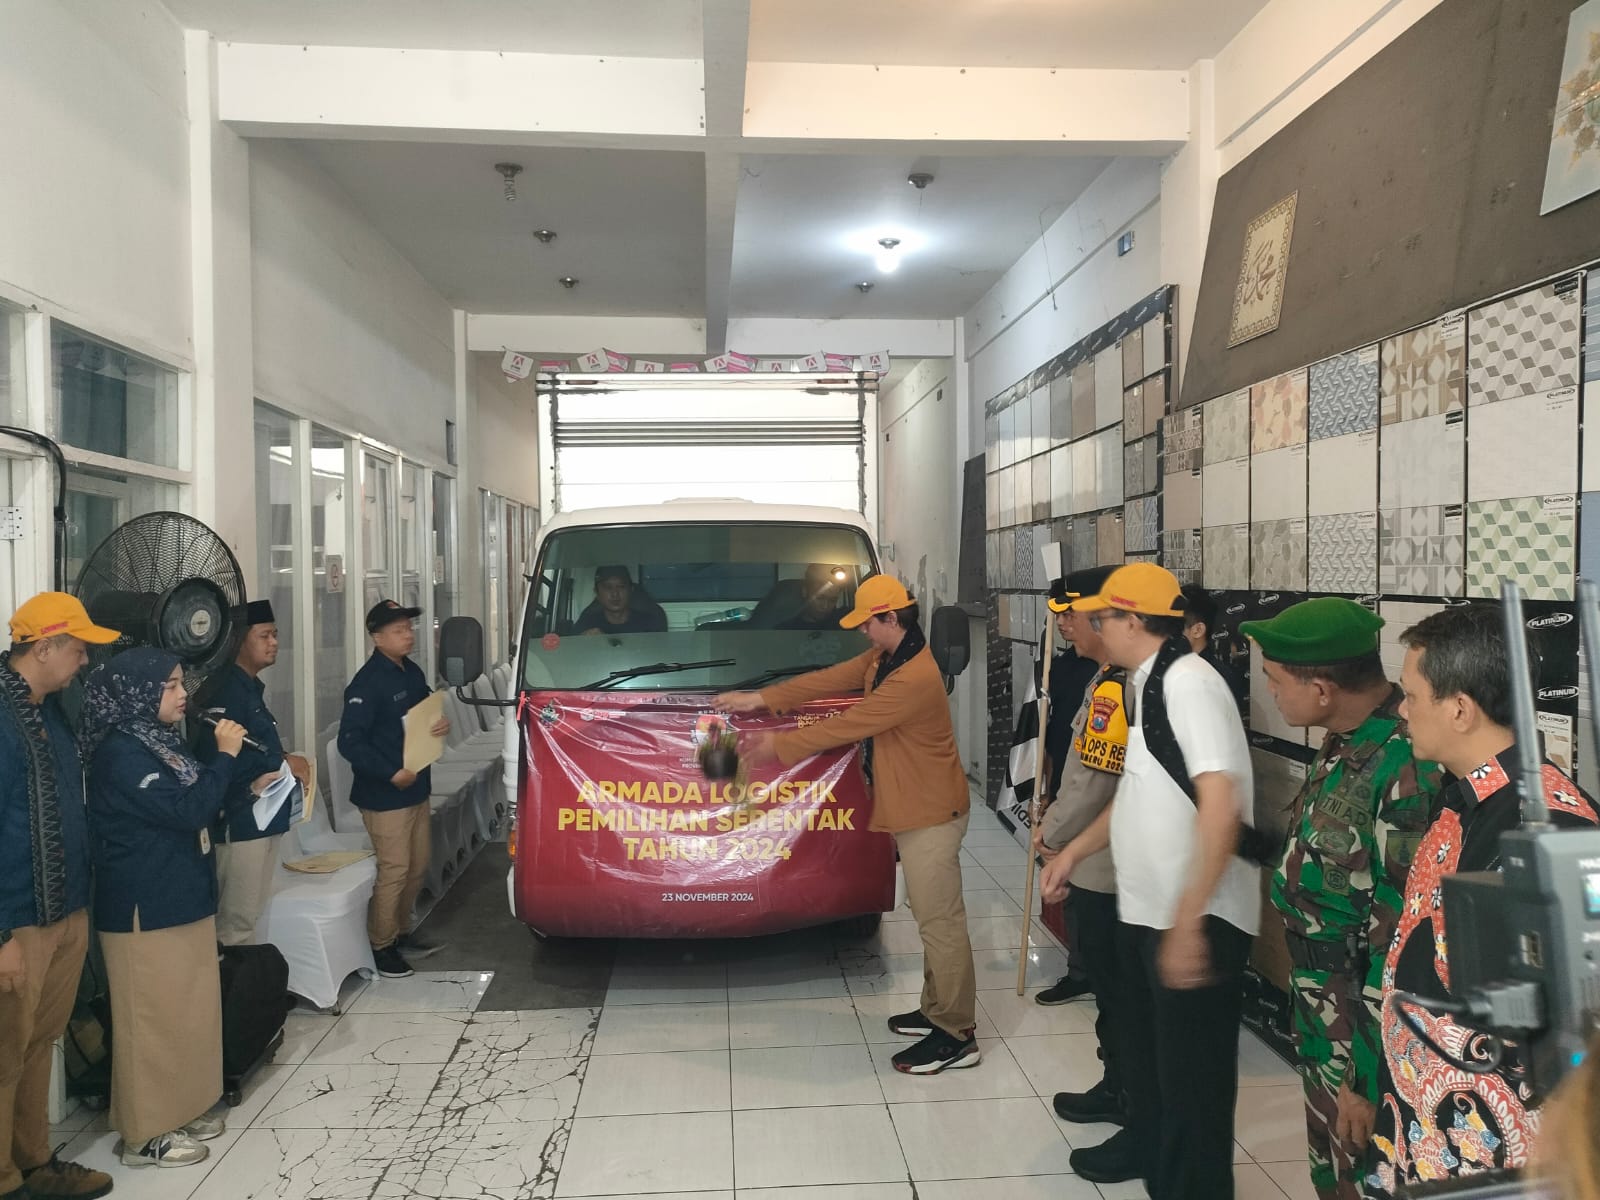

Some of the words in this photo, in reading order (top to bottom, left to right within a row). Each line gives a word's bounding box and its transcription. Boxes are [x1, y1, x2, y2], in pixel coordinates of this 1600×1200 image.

[1529, 613, 1570, 627] PLATINUM
[1538, 686, 1577, 698] PLATINUM
[1088, 739, 1107, 757] OPS
[577, 781, 703, 803] ARMADA
[710, 781, 837, 803] LOGISTIK
[558, 808, 707, 831] PEMILIHAN
[1322, 796, 1343, 815] TNI
[1343, 805, 1368, 825] AD
[623, 837, 717, 860] TAHUN
[725, 837, 792, 860] 2024
[661, 893, 673, 901] 23
[675, 893, 729, 901] NOVEMBER
[731, 893, 754, 901] 2024
